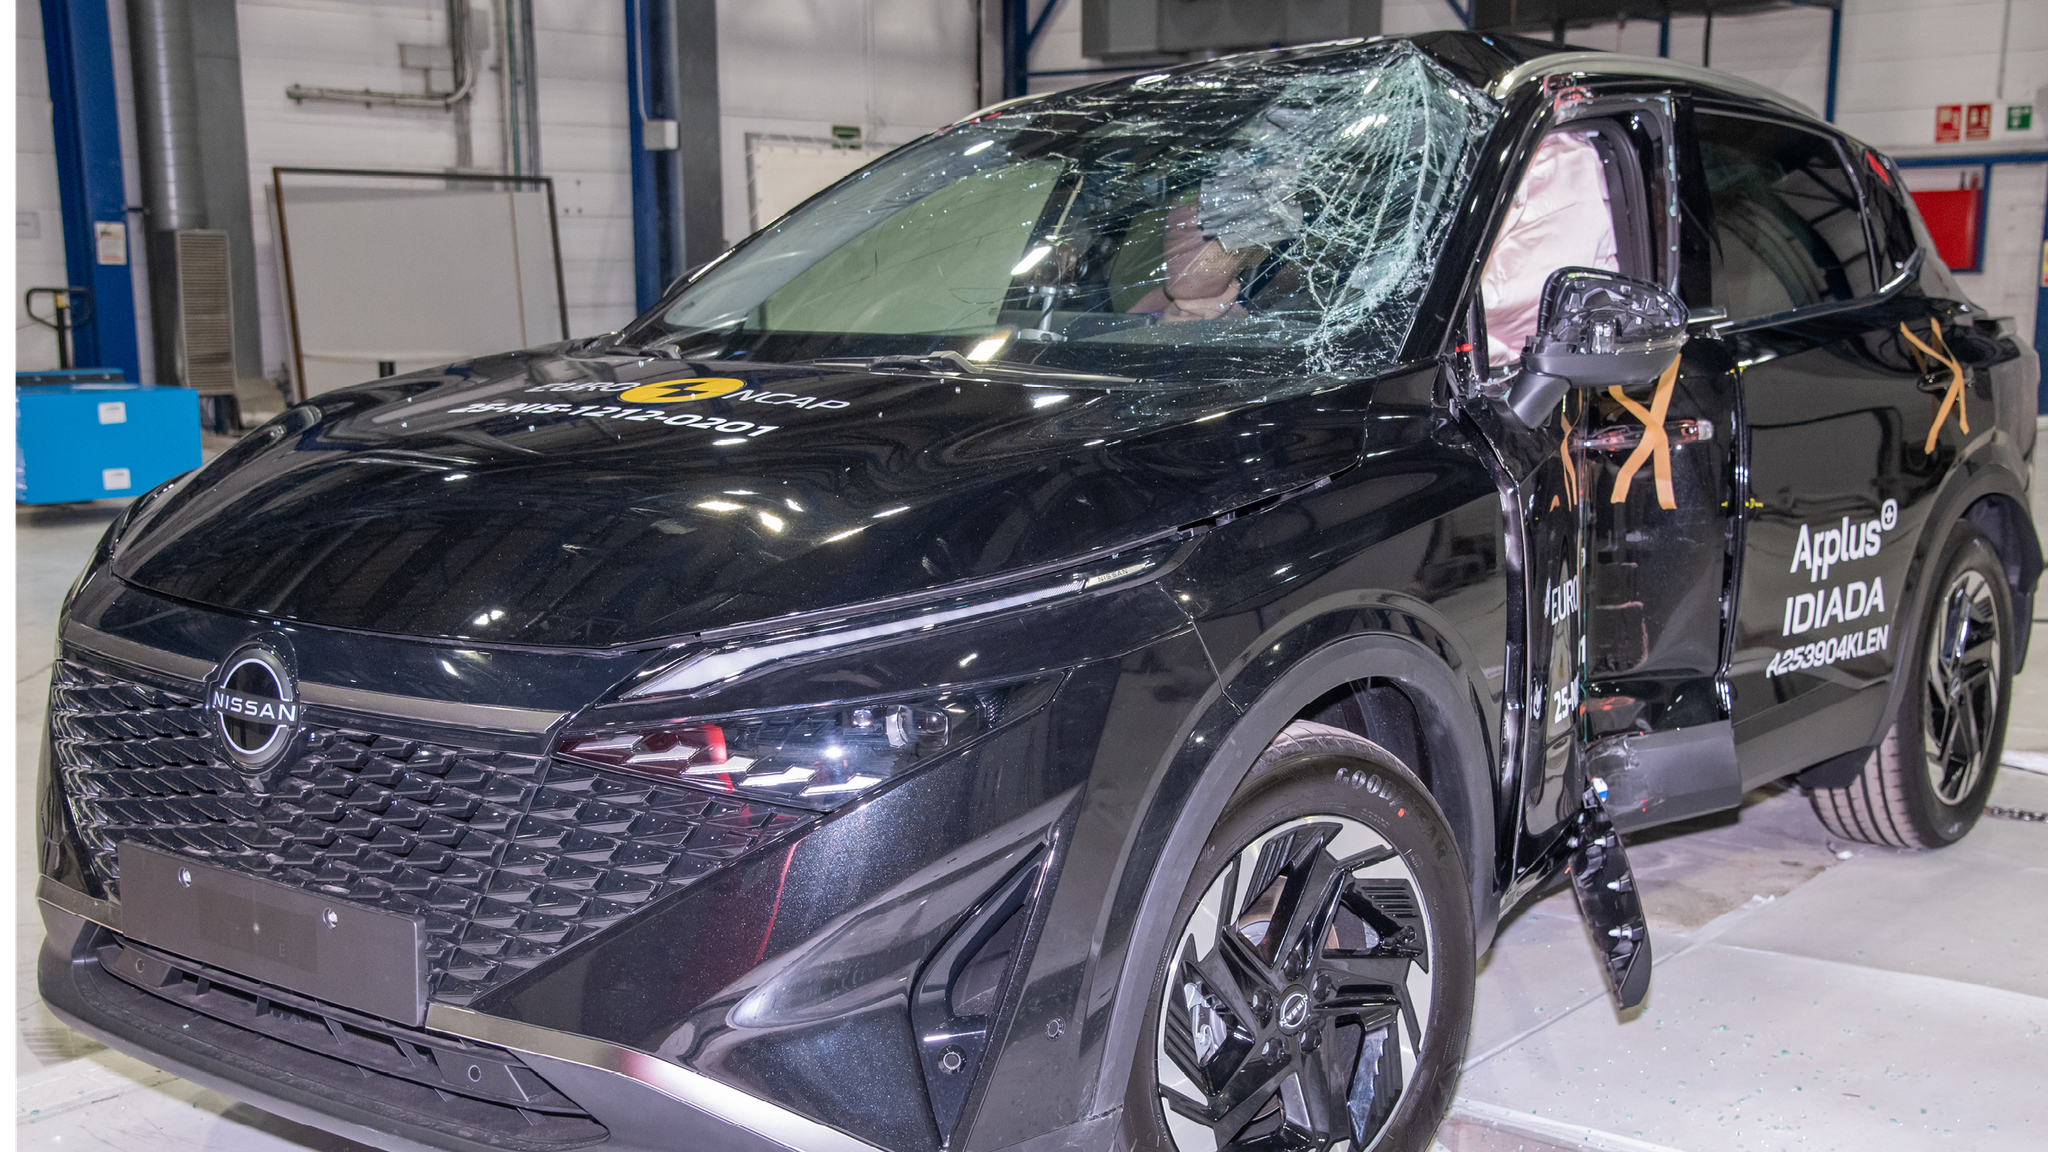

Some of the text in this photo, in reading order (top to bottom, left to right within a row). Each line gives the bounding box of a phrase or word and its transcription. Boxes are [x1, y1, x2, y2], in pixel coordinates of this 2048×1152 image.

[525, 382, 851, 410] EURO NCAP
[447, 402, 780, 437] 25-NIS-1212-0201
[1097, 568, 1129, 582] NISSAN
[1551, 574, 1579, 626] EURO
[1782, 576, 1886, 637] IDIADA
[1765, 624, 1890, 679] A253904KLEN
[212, 690, 297, 723] NISSAN
[1279, 993, 1309, 1028] NISSAN
